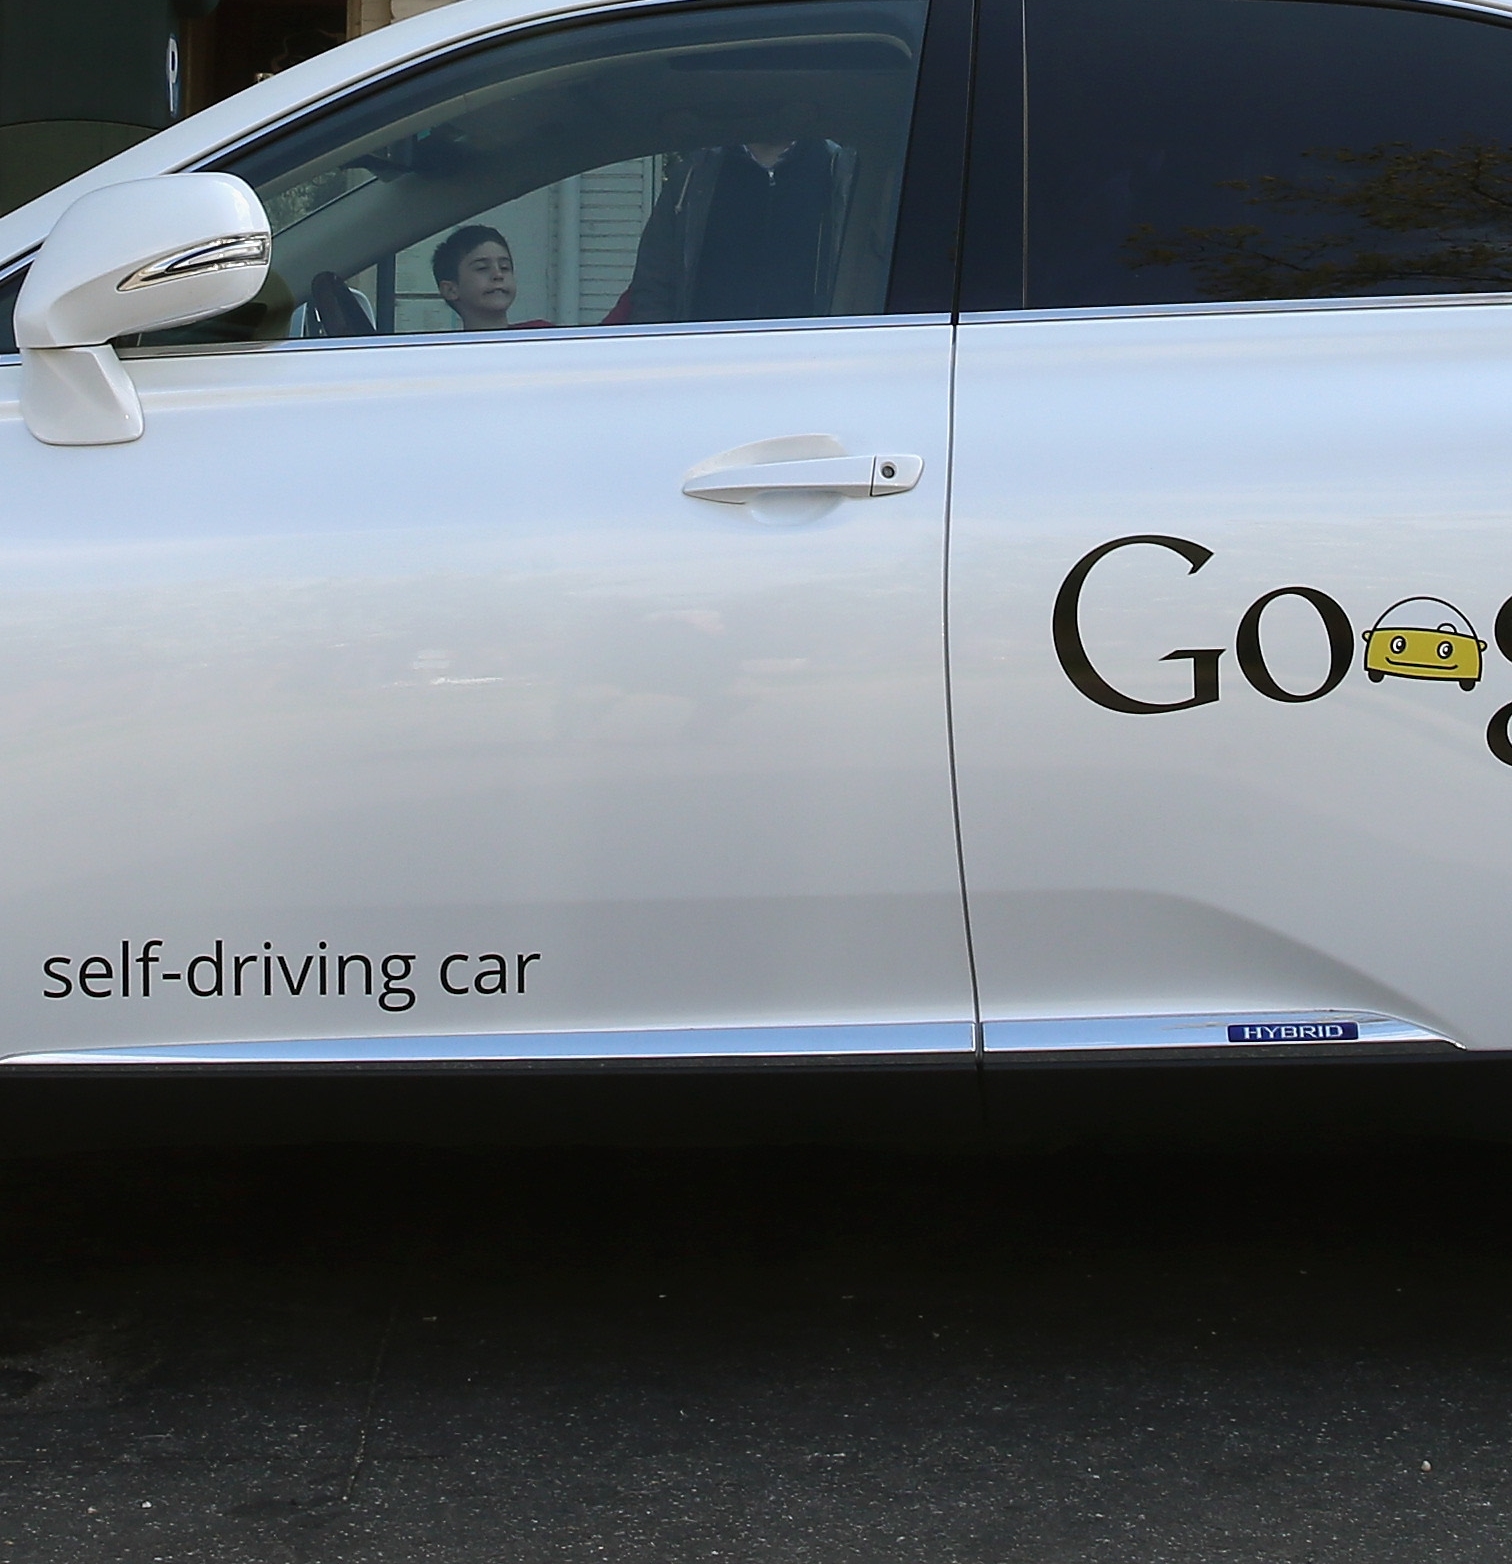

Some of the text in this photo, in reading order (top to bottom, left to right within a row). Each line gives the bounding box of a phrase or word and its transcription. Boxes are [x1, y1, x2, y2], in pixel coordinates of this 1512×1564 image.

[42, 940, 542, 1013] self-driving car
[1243, 1025, 1345, 1039] HYBRID
